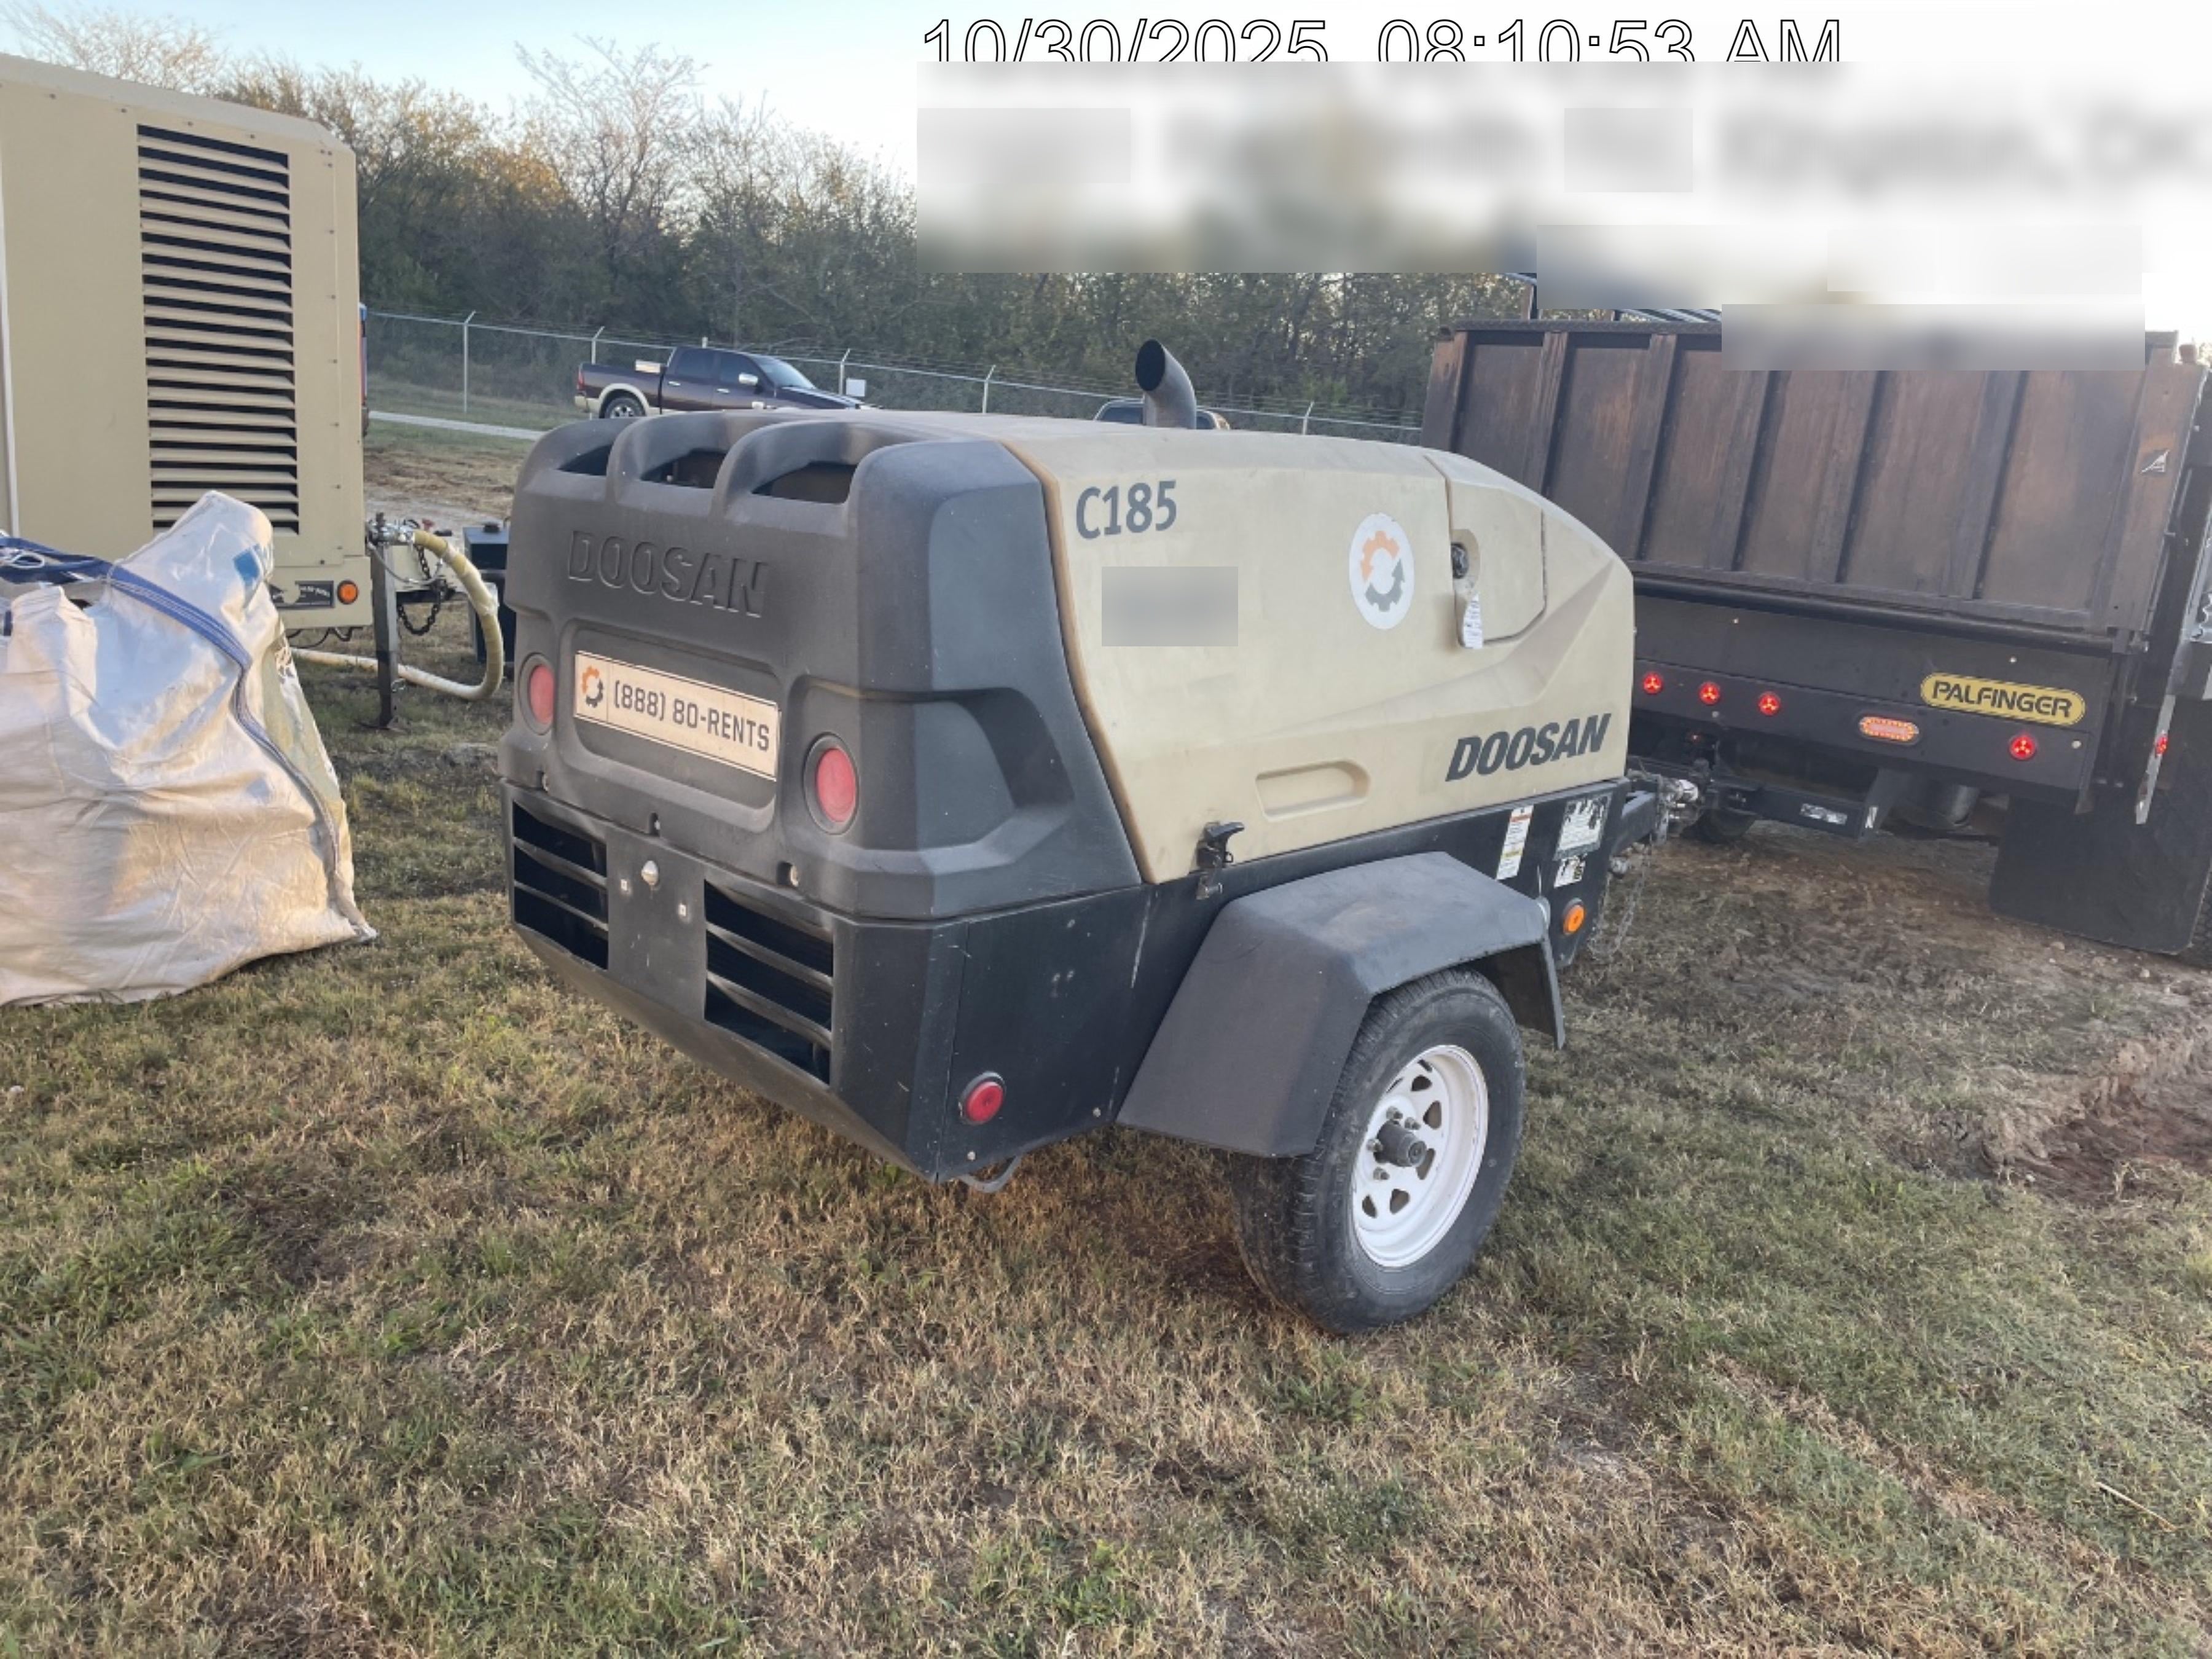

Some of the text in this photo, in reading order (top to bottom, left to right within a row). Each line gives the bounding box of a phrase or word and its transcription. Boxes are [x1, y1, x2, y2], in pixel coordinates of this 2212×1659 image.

[1075, 479, 1177, 539] C185
[567, 530, 768, 618] DOOSAN
[614, 680, 770, 752] (888) 80-RENTS
[1932, 680, 2072, 718] PALFINGER
[1445, 713, 1612, 782] DOOSAN
